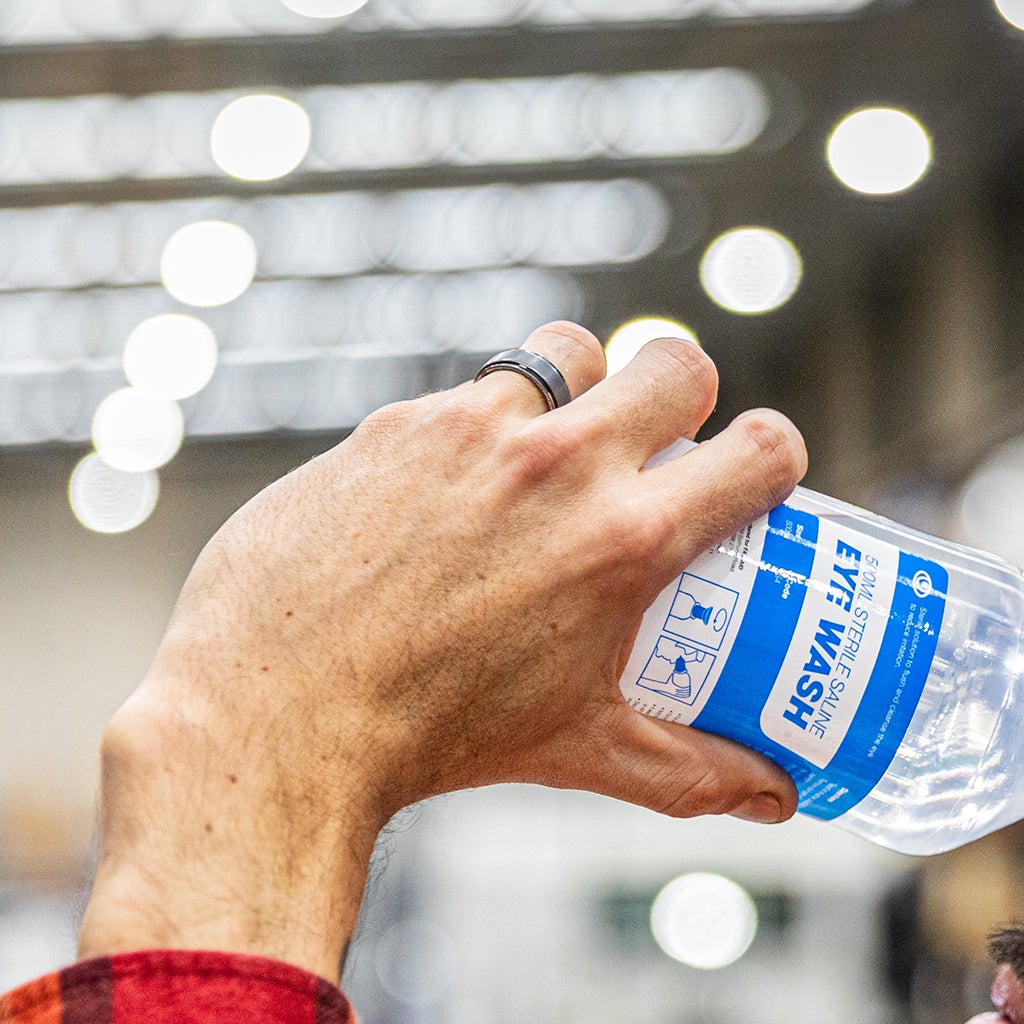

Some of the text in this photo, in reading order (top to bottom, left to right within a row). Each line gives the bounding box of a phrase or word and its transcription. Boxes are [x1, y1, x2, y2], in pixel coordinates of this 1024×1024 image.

[825, 538, 862, 612] EYE
[860, 553, 878, 601] 500ML
[781, 578, 793, 599] Code
[909, 602, 917, 611] to
[903, 611, 915, 637] reduce
[834, 606, 868, 680] STERILE
[908, 630, 920, 659] solution
[782, 618, 845, 730] WASH
[904, 658, 913, 668] to
[899, 669, 910, 687] flush
[892, 687, 902, 703] and
[808, 677, 846, 740] SALINE
[880, 703, 896, 732] cleanse
[866, 745, 877, 758] eye
[873, 732, 884, 745] the
